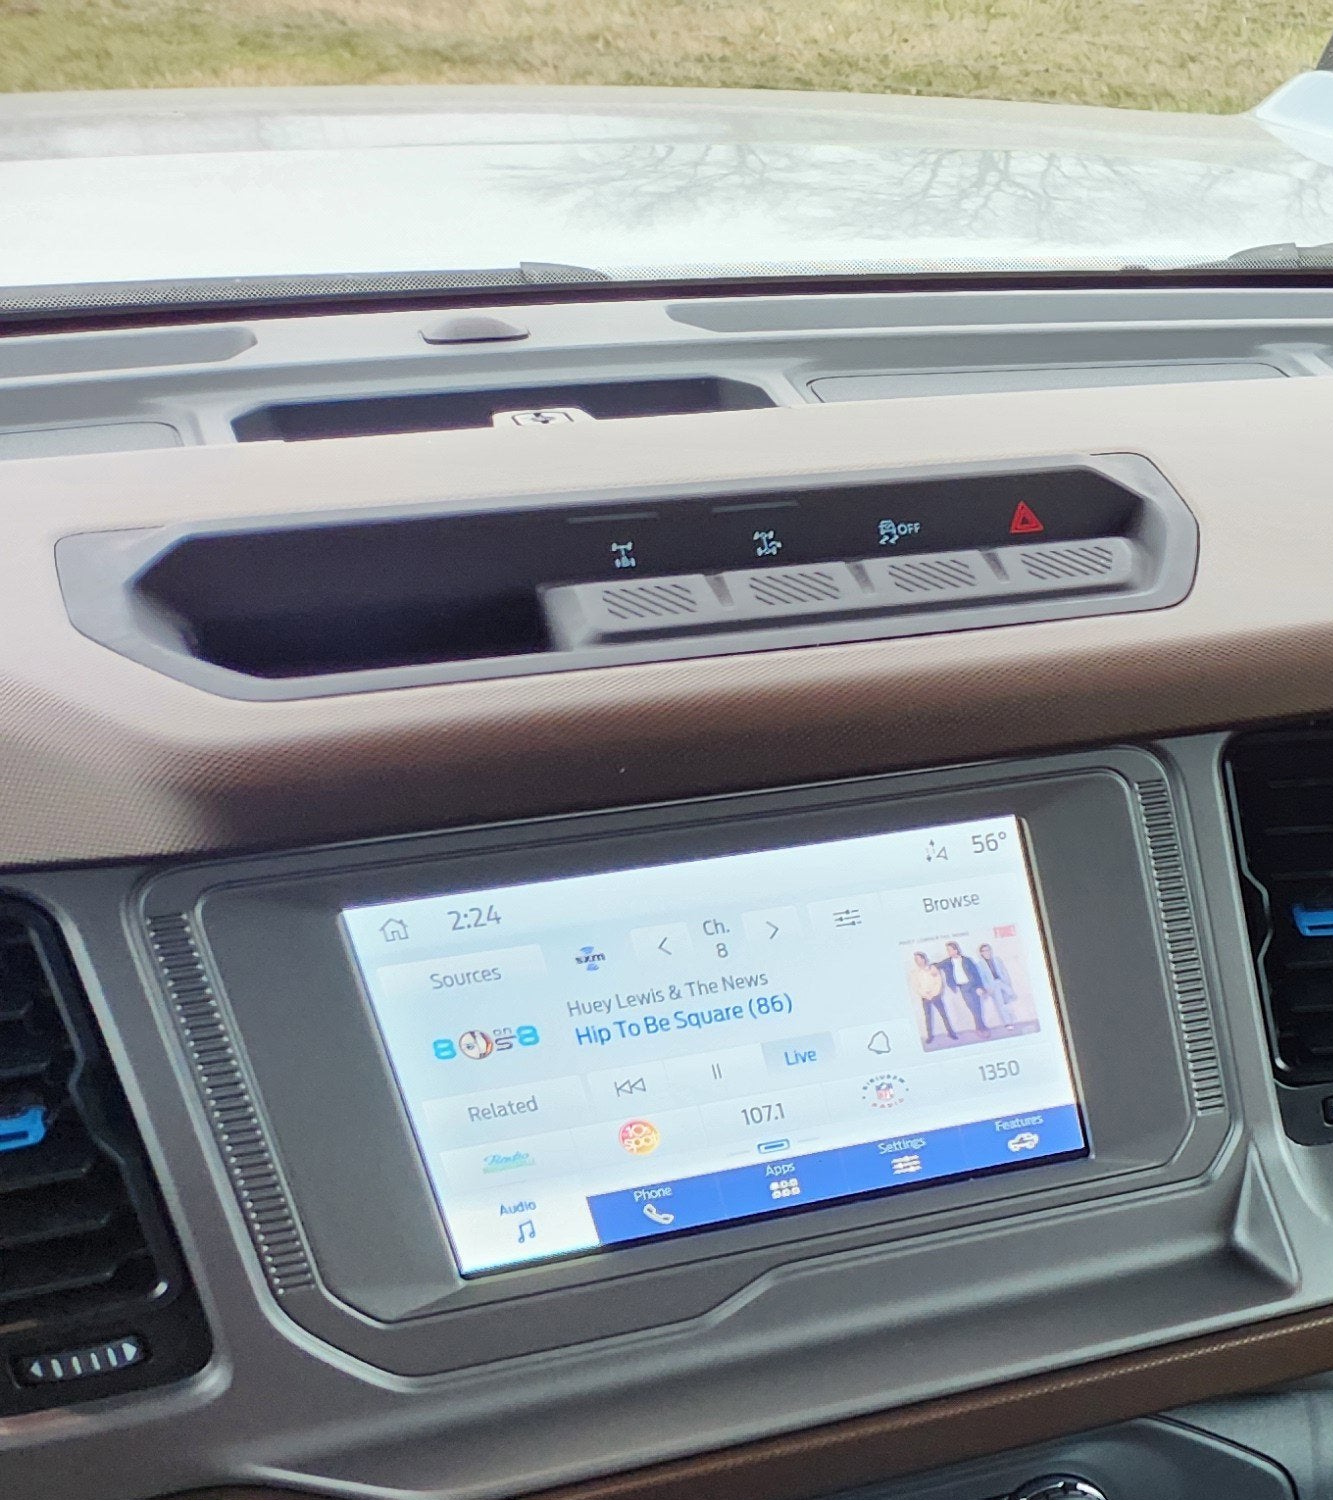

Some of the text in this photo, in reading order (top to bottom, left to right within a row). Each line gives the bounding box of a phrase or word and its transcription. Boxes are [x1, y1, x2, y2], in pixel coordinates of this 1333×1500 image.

[896, 521, 921, 535] OFF
[922, 892, 981, 914] Browse
[447, 904, 502, 931] 2:24
[702, 918, 731, 936] Ch.
[717, 942, 729, 959] 8
[430, 966, 502, 990] Sources
[567, 972, 769, 1018] Huey Lewis & The News
[575, 992, 793, 1046] Hip To Be Square (86)
[784, 1049, 817, 1066] Live
[978, 1060, 1021, 1082] 1350
[467, 1095, 539, 1122] Related
[741, 1102, 785, 1126] 107.1
[994, 1115, 1044, 1132] Features
[877, 1136, 926, 1155] Settings
[765, 1162, 796, 1177] Apps
[633, 1185, 673, 1202] Phone
[499, 1199, 536, 1217] Audio
